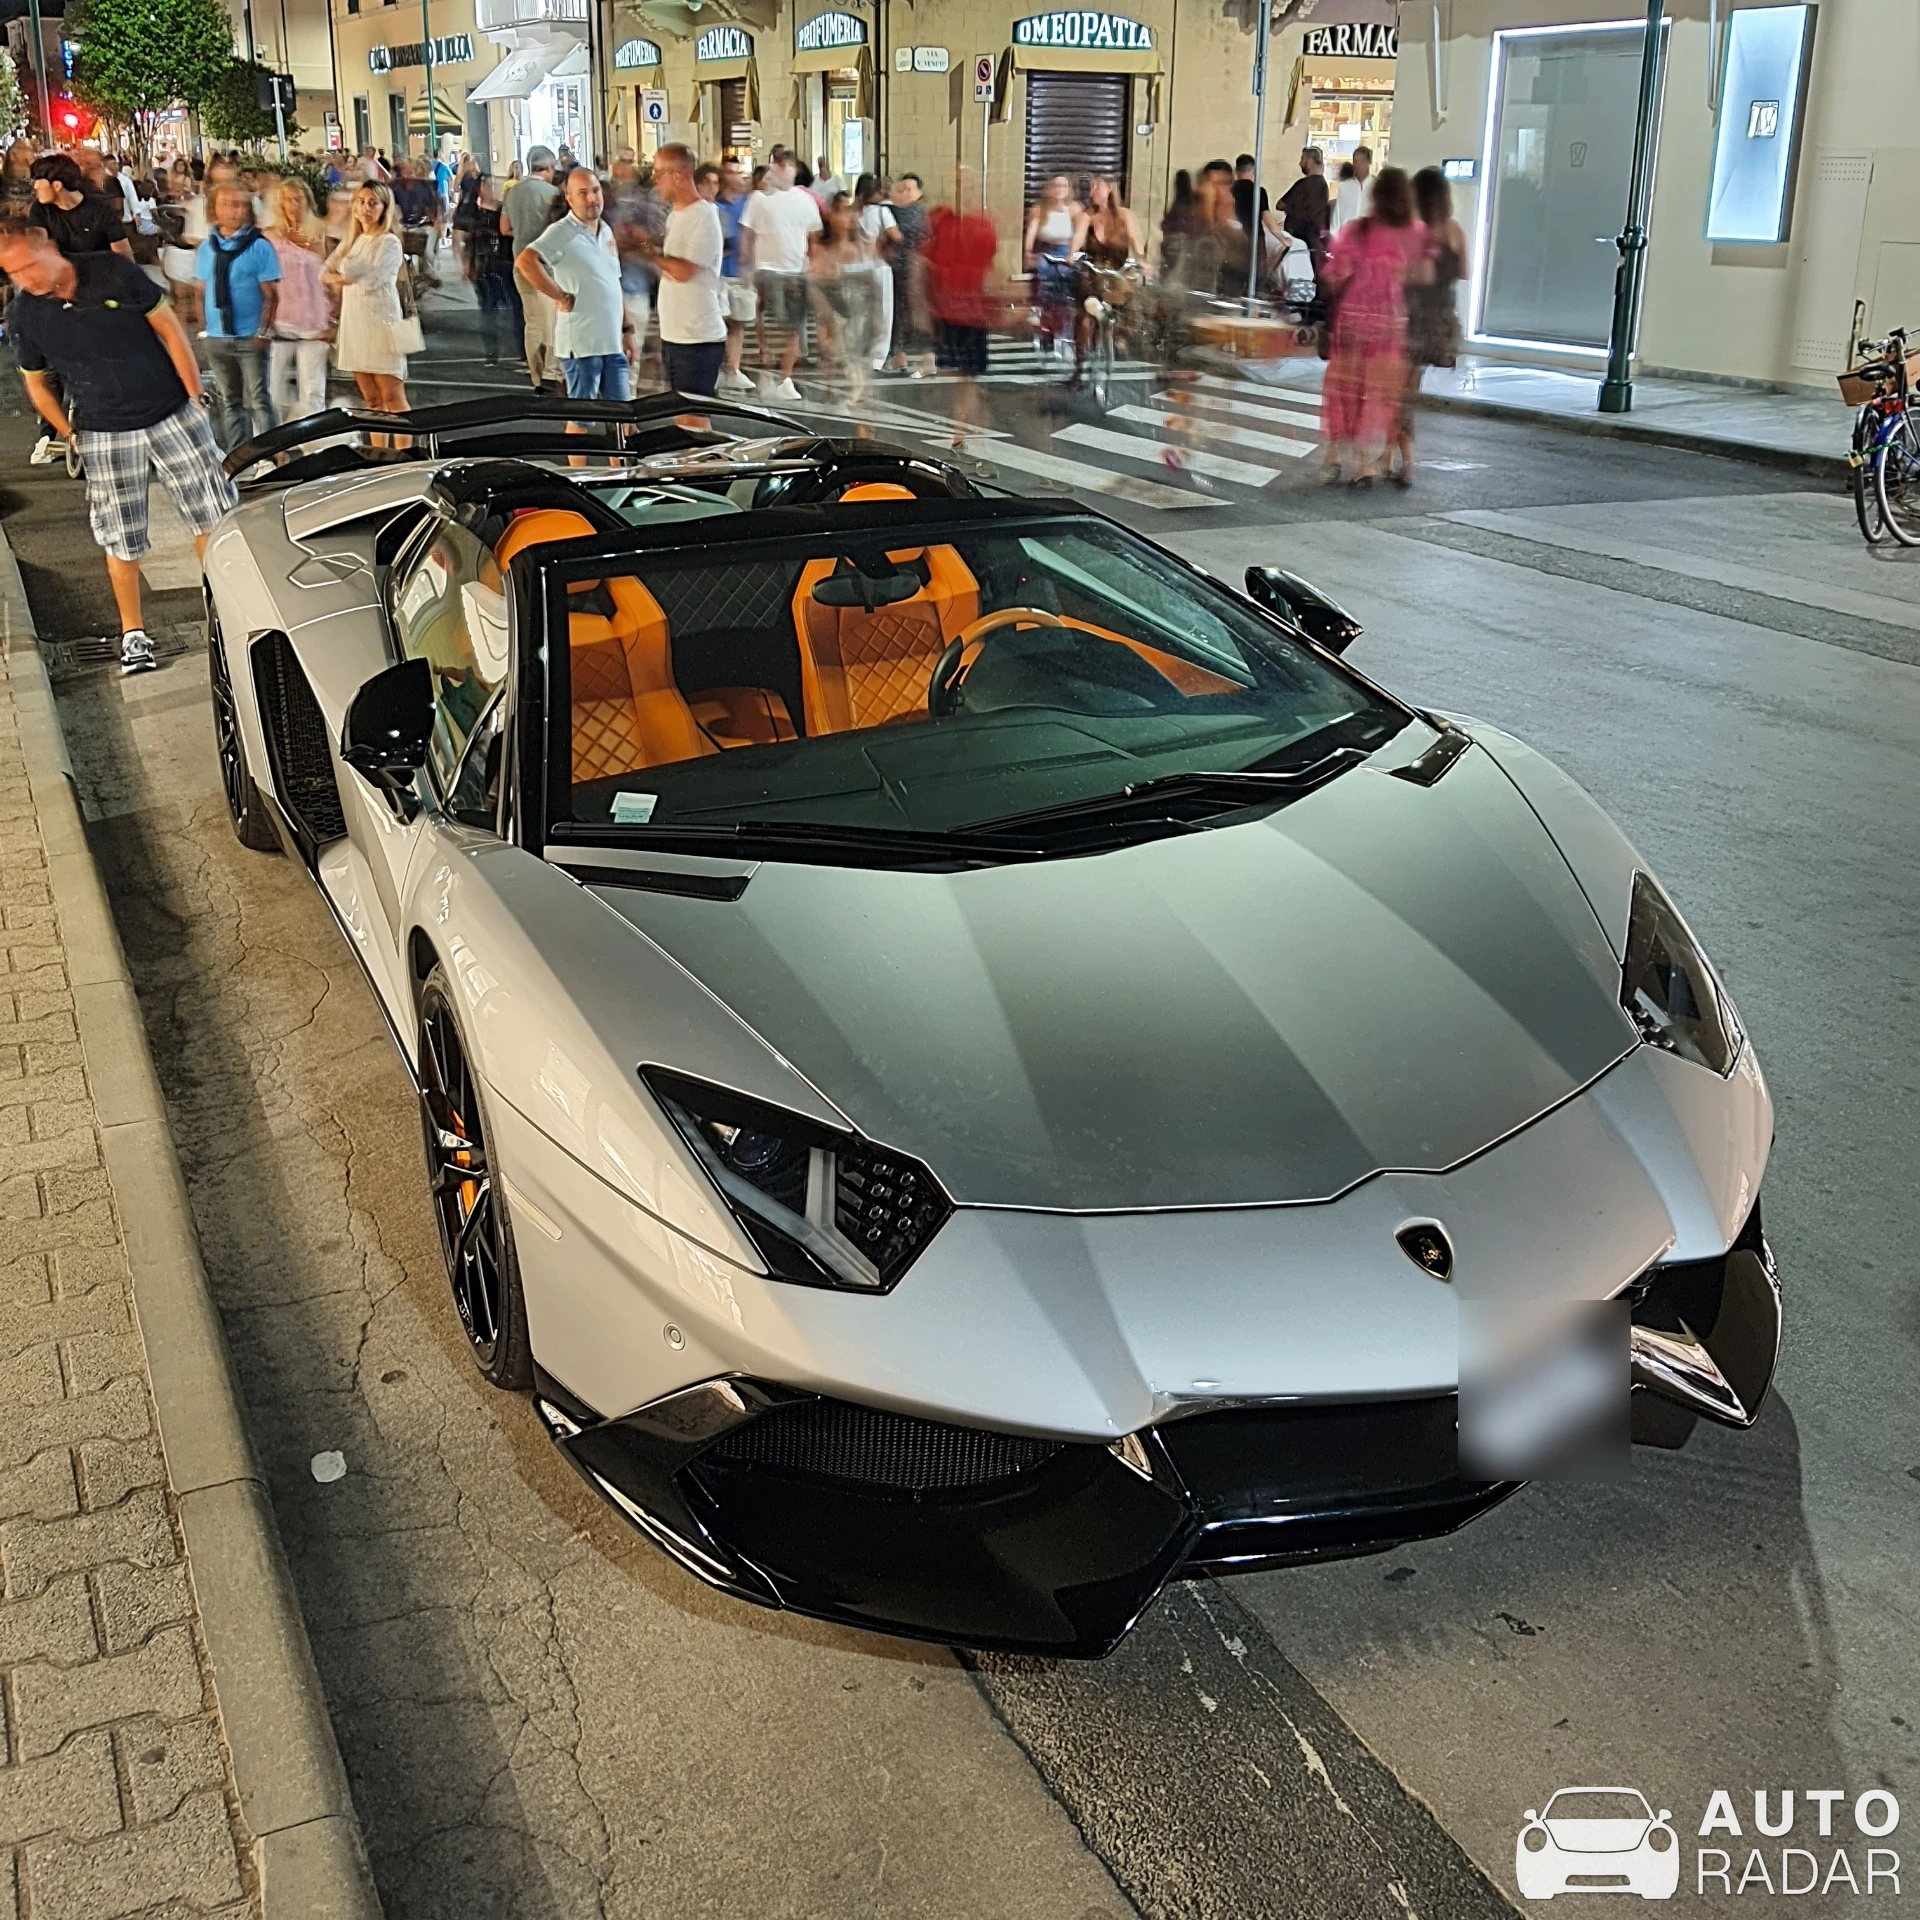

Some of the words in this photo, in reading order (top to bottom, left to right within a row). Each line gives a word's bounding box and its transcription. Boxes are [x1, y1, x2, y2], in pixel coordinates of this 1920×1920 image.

[698, 27, 749, 60] FARMACIA
[798, 12, 861, 48] PROFUMERIA
[1019, 12, 1152, 48] OMEOPATIA
[615, 39, 658, 68] PROFUMERIA
[924, 59, 947, 68] VENETO
[926, 49, 939, 58] VIA
